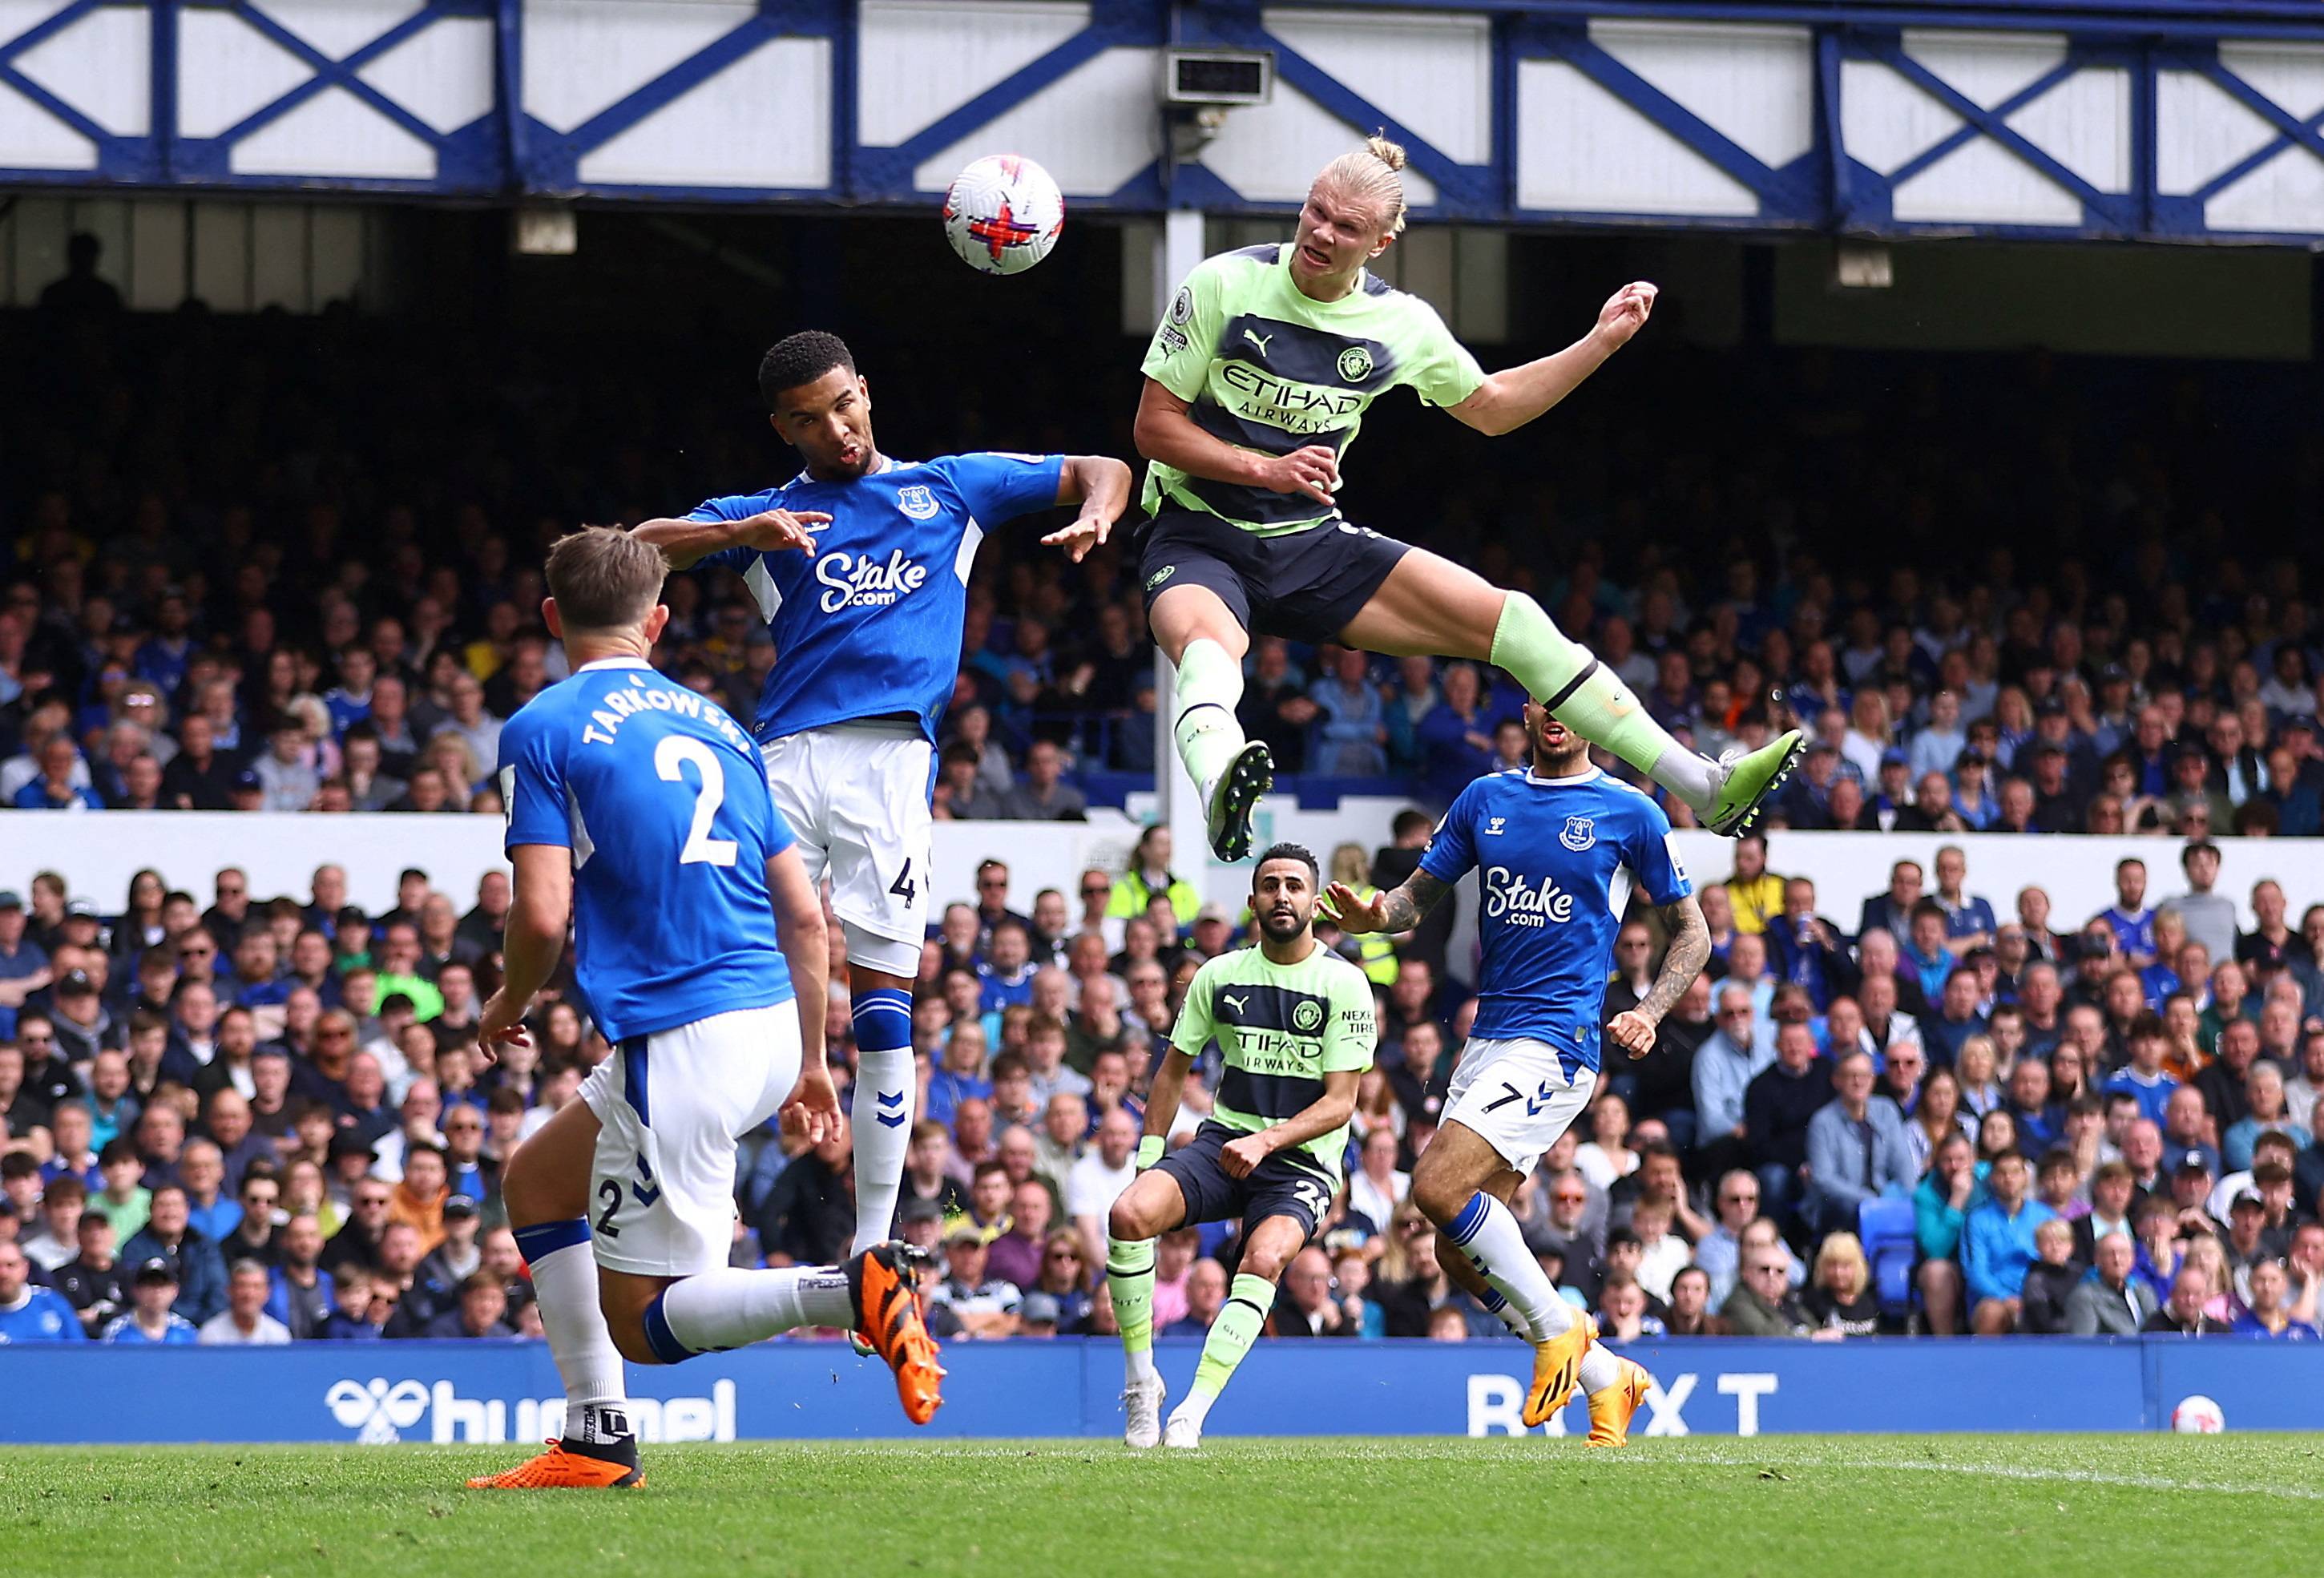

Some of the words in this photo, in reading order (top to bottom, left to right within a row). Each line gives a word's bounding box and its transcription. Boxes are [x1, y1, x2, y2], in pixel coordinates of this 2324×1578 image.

[1223, 365, 1361, 415] ETIHAD
[1238, 402, 1330, 433] AIRWAYS
[816, 549, 926, 613] Stake
[847, 591, 896, 606] .com
[654, 735, 738, 866] 2
[890, 858, 915, 909] 4
[1487, 866, 1573, 922] Stake
[1505, 913, 1544, 927] .com
[1234, 1031, 1322, 1058] TIHAD
[1241, 1056, 1304, 1072] IRWAYS
[1481, 1082, 1523, 1115] 7
[596, 1180, 622, 1237] 2
